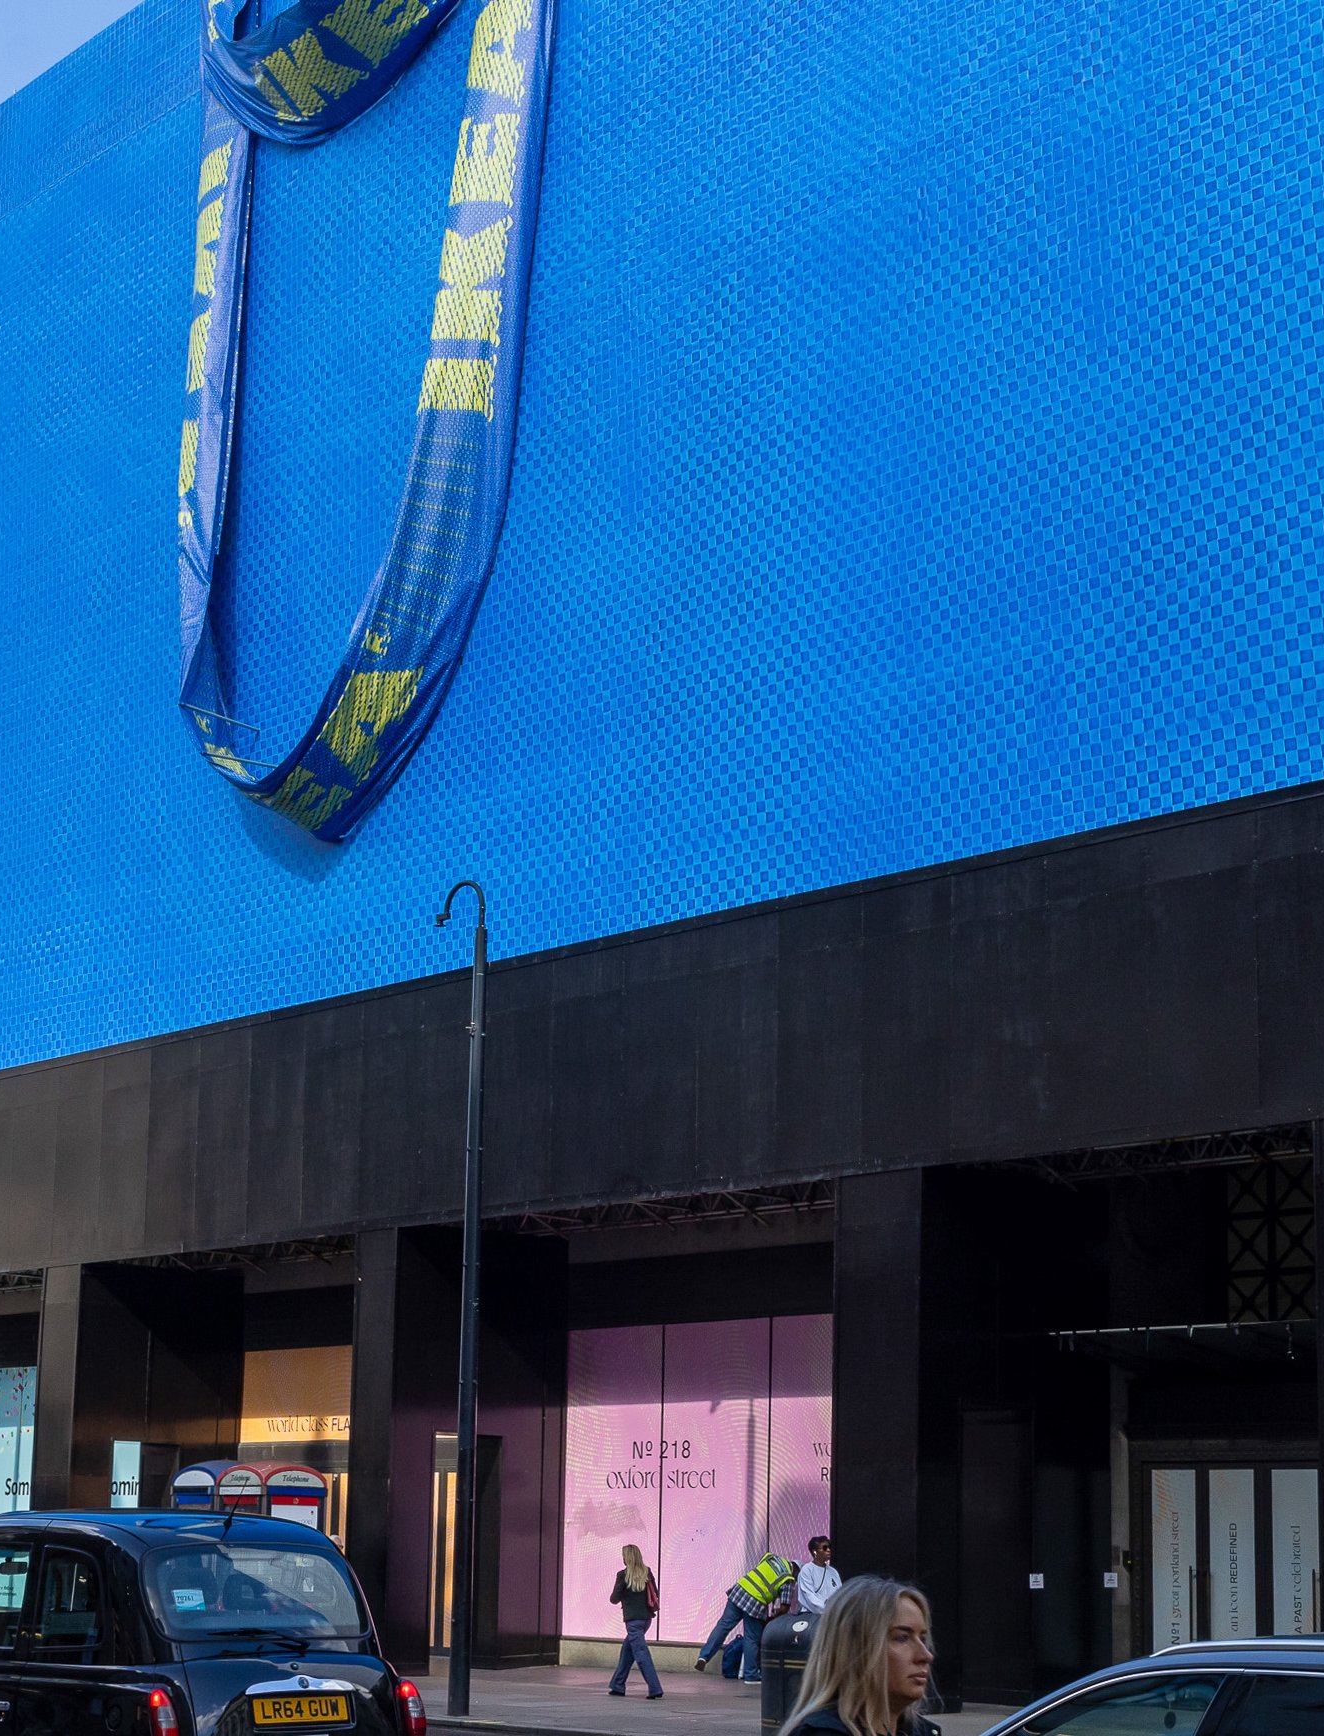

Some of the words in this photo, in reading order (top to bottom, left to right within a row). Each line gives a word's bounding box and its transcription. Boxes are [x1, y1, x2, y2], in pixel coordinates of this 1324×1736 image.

[267, 1415, 299, 1432] world
[302, 1415, 329, 1432] class
[660, 1440, 691, 1459] 218
[282, 1475, 310, 1484] Telephone
[667, 1469, 717, 1489] street
[1229, 1523, 1238, 1584] REDEFINED
[1290, 1525, 1302, 1593] celebrated
[1170, 1543, 1182, 1588] portland
[1228, 1586, 1239, 1614] icon
[1293, 1595, 1303, 1624] PAST
[1229, 1616, 1238, 1632] an
[1294, 1625, 1303, 1634] A
[261, 1700, 304, 1719] LR64
[308, 1699, 340, 1717] GUW
